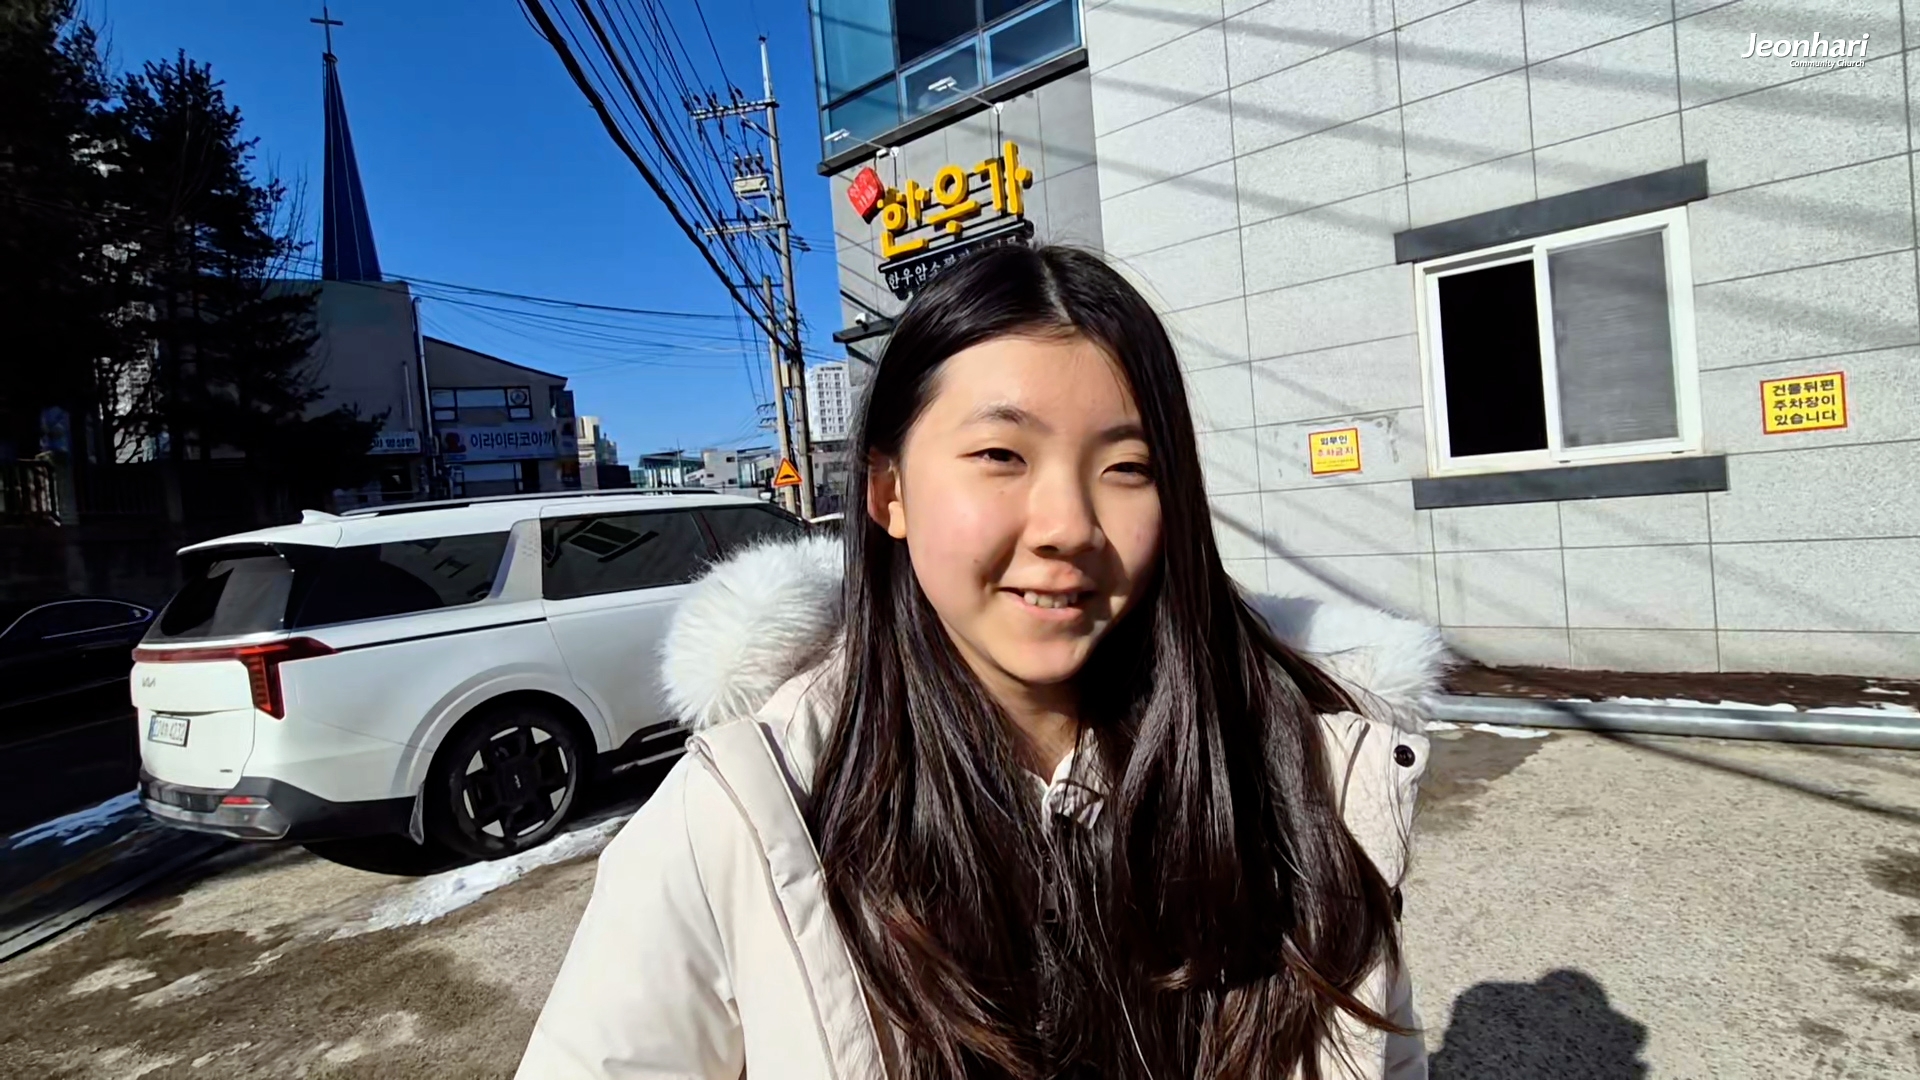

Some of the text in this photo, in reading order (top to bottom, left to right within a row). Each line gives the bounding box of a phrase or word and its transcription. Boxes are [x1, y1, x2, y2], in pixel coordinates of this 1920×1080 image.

[877, 140, 1033, 260] 한우가
[1772, 379, 1834, 397] 건물뒤편
[1773, 394, 1836, 411] 주차장이
[1774, 409, 1837, 426] 있습니다
